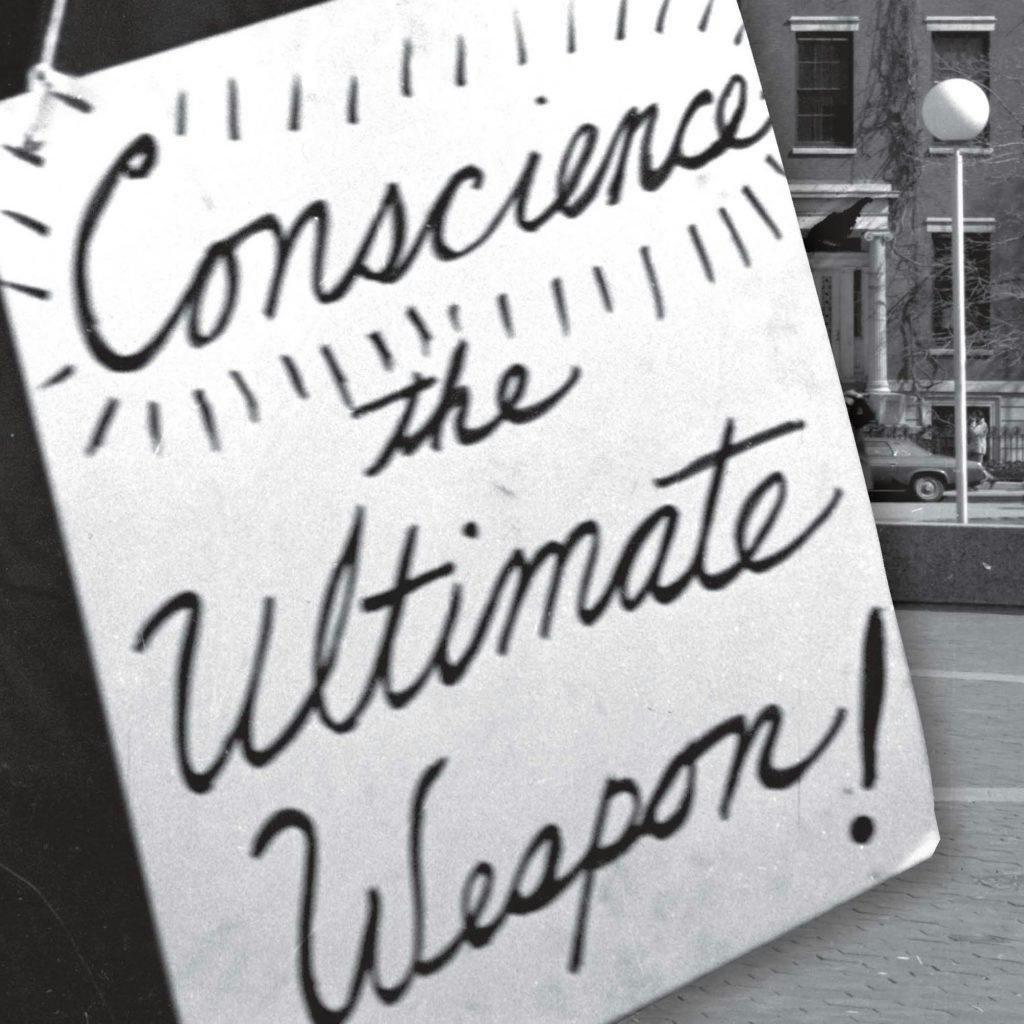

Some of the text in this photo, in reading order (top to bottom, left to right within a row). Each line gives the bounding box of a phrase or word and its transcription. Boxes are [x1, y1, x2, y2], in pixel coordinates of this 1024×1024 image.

[74, 73, 772, 373] Conscience
[350, 339, 582, 477] the
[133, 417, 844, 794] Ultimate
[249, 606, 886, 1024] Weapon!
